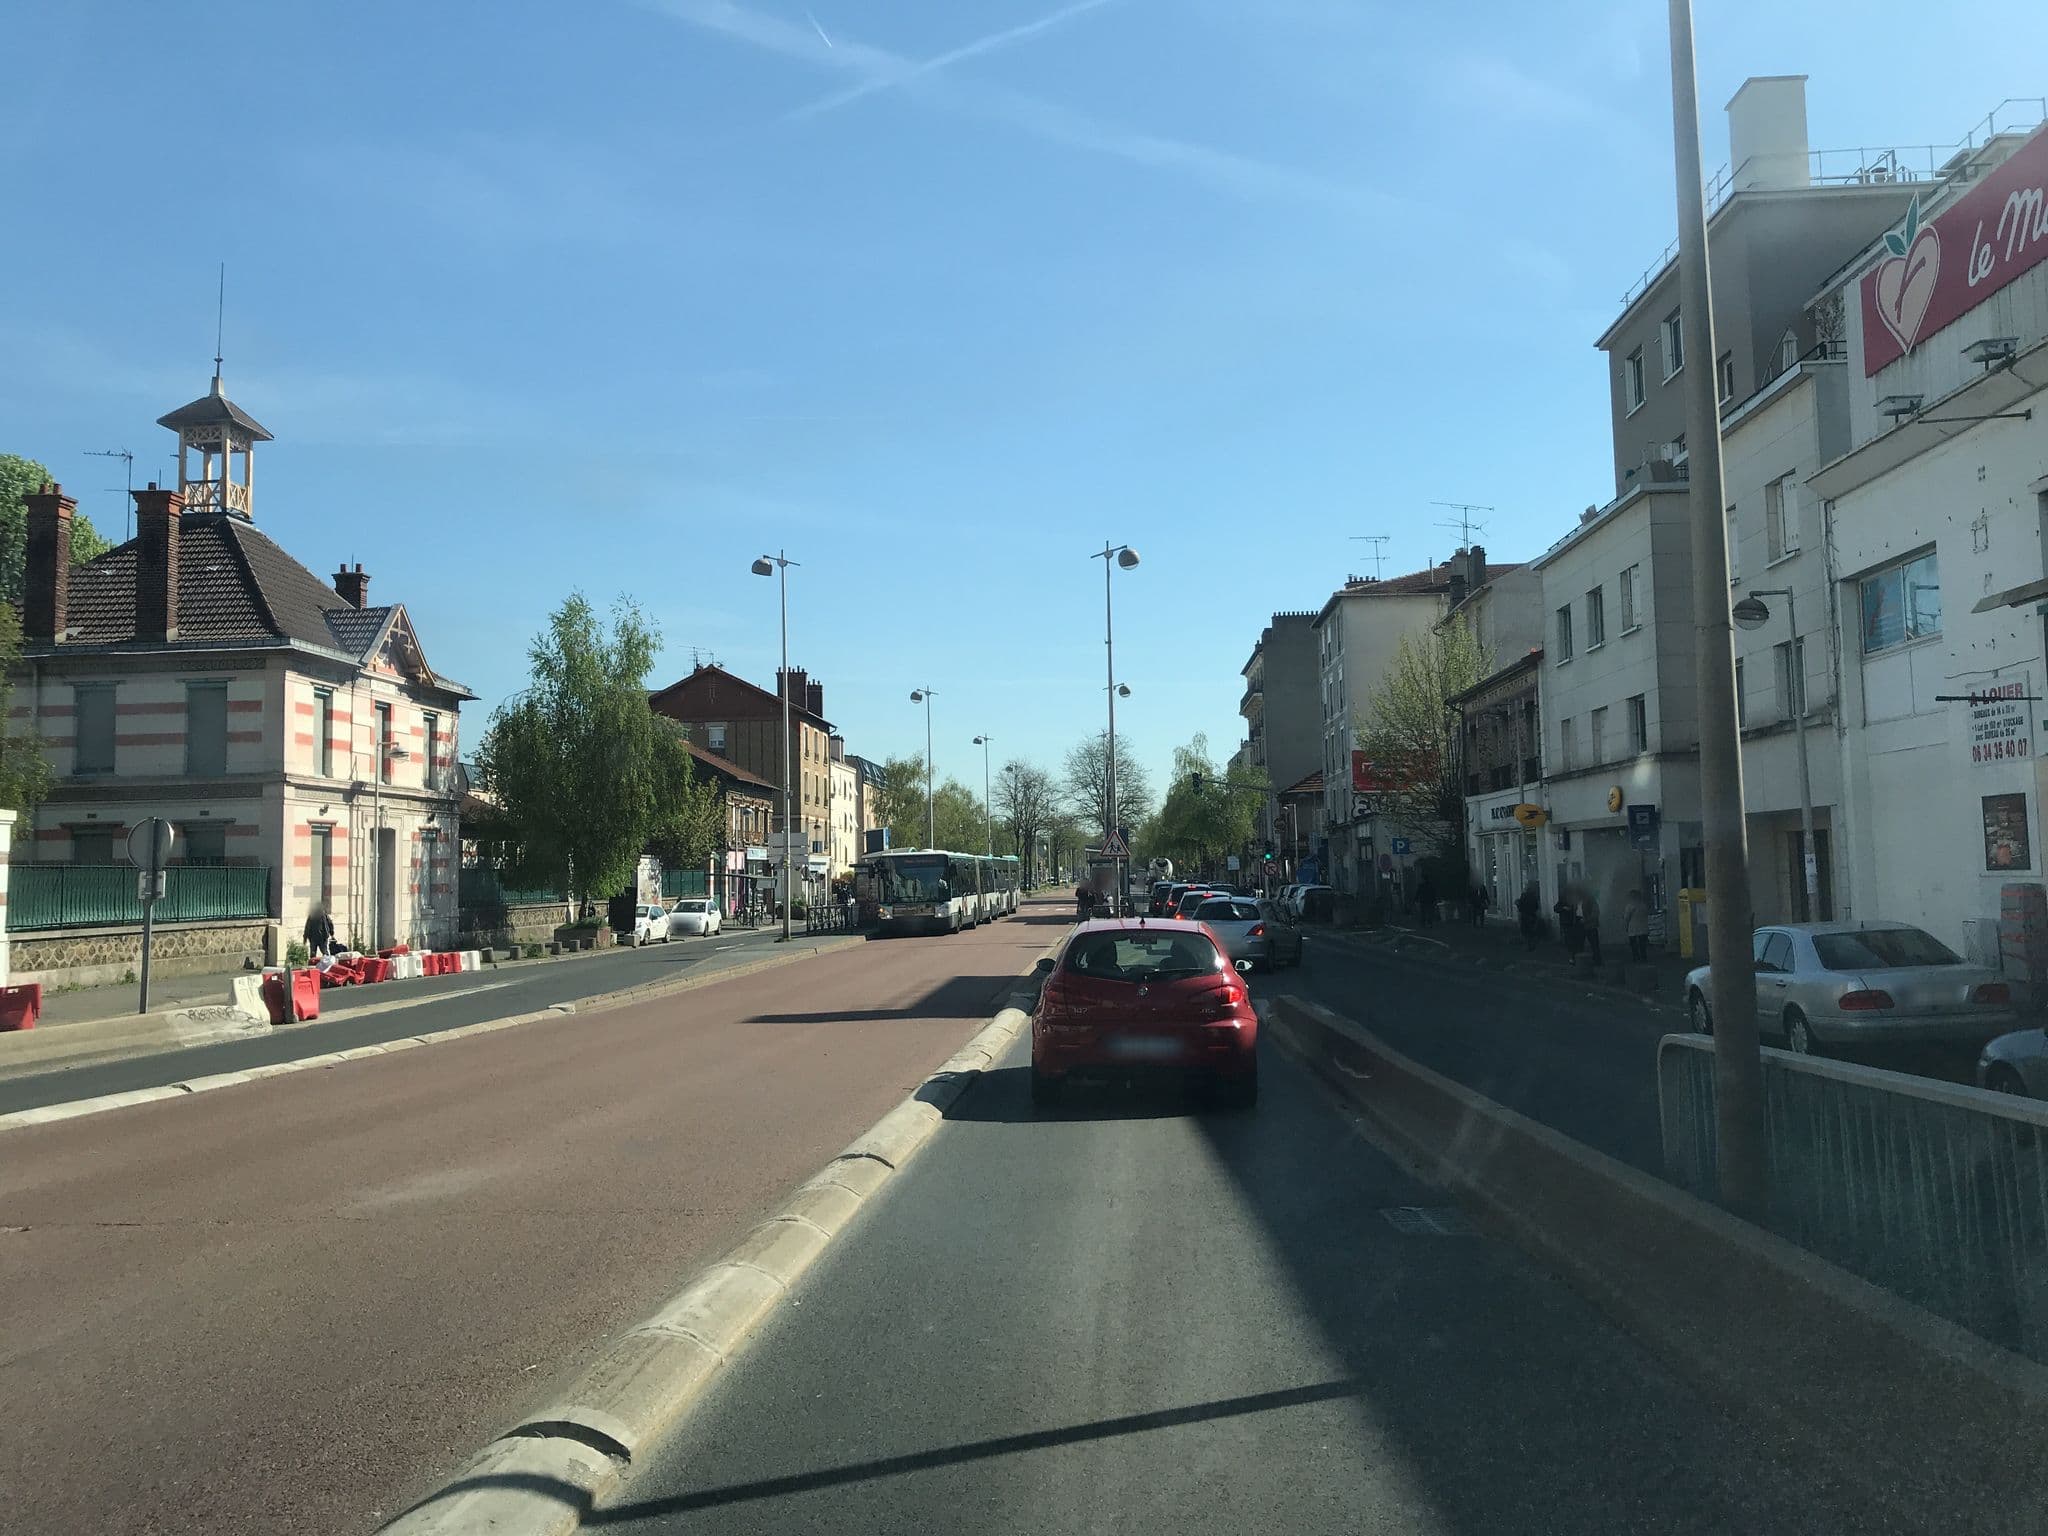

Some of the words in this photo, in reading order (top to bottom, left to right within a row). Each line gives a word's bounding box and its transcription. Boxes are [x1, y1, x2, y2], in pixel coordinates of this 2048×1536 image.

[1968, 219, 1996, 287] le
[1983, 682, 2024, 704] LOUER
[1972, 745, 1982, 763] 06
[2006, 739, 2016, 758] 40
[2017, 738, 2028, 756] 07
[1396, 840, 1405, 852] P
